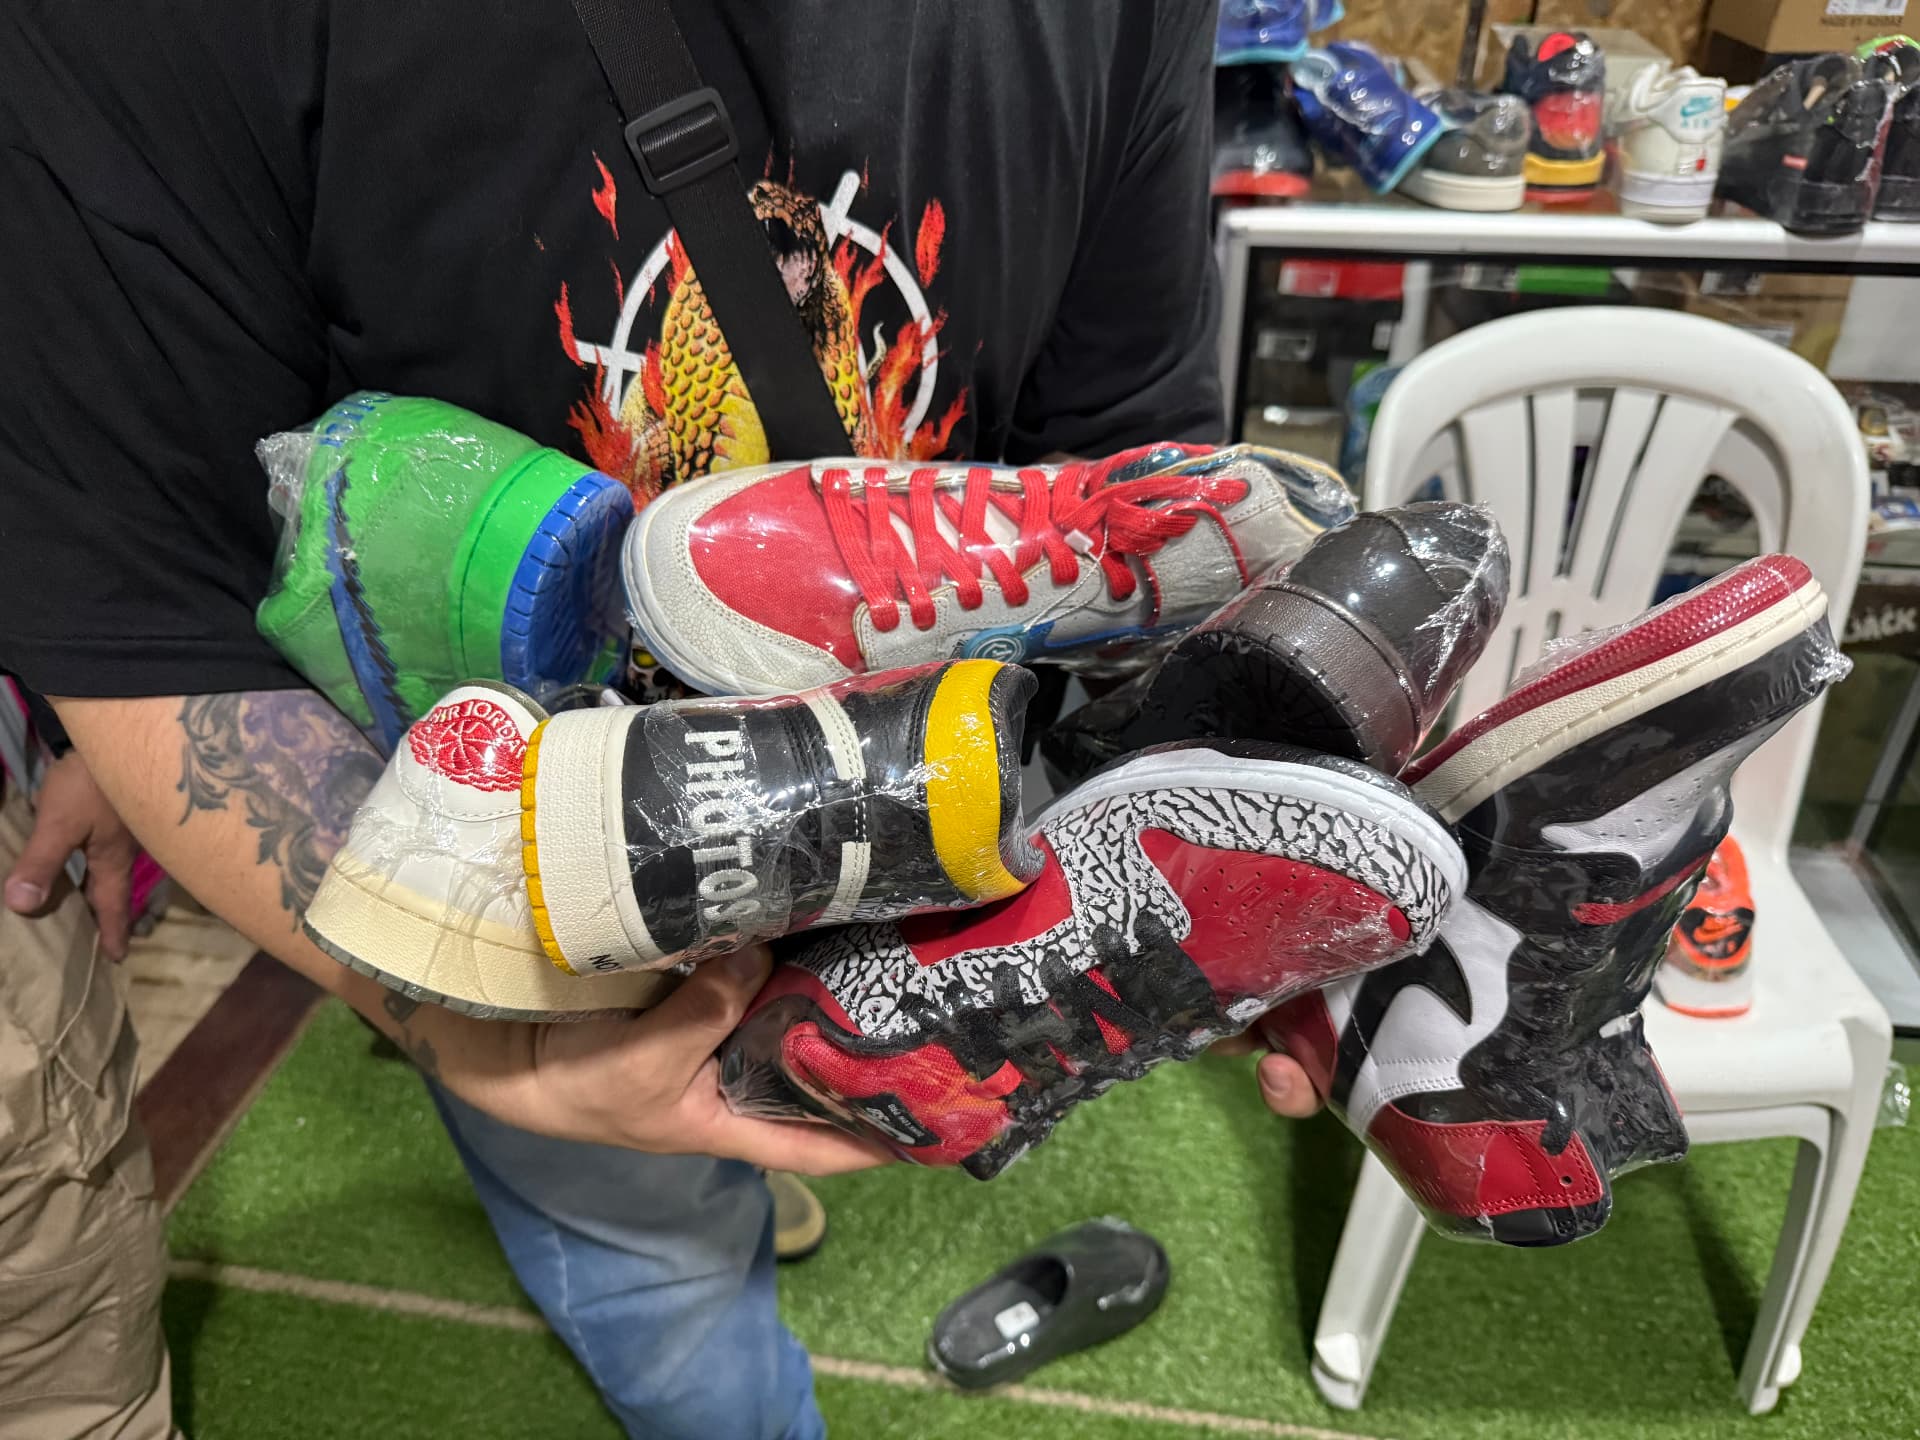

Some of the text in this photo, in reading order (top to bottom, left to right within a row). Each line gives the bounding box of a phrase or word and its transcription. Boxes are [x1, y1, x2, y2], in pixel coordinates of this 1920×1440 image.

[429, 705, 460, 723] AIR
[685, 730, 760, 921] PHOTOS
[588, 954, 624, 973] NO
[887, 1103, 901, 1116] PRO
